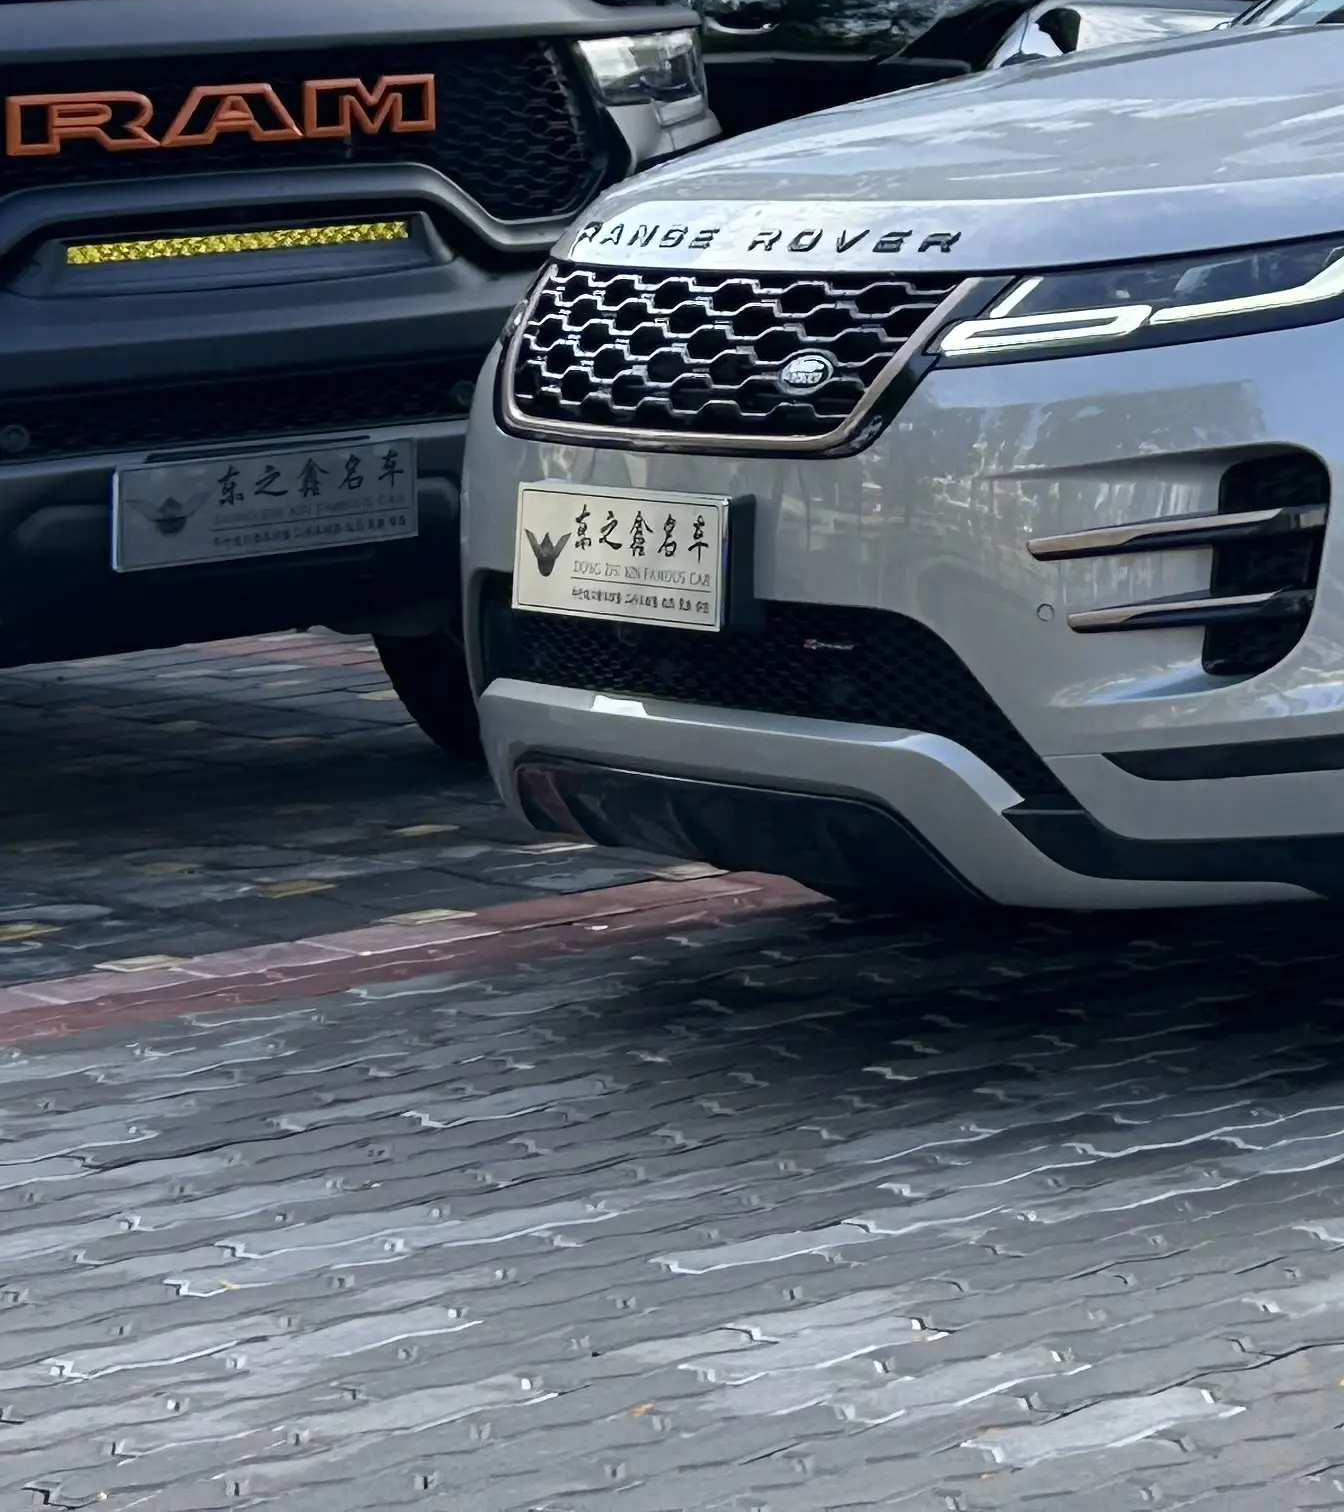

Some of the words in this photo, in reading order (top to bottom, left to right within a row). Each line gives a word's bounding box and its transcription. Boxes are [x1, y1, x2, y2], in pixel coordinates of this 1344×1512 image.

[6, 73, 436, 157] RAM
[577, 221, 720, 250] RANGE
[747, 228, 962, 255] ROVER
